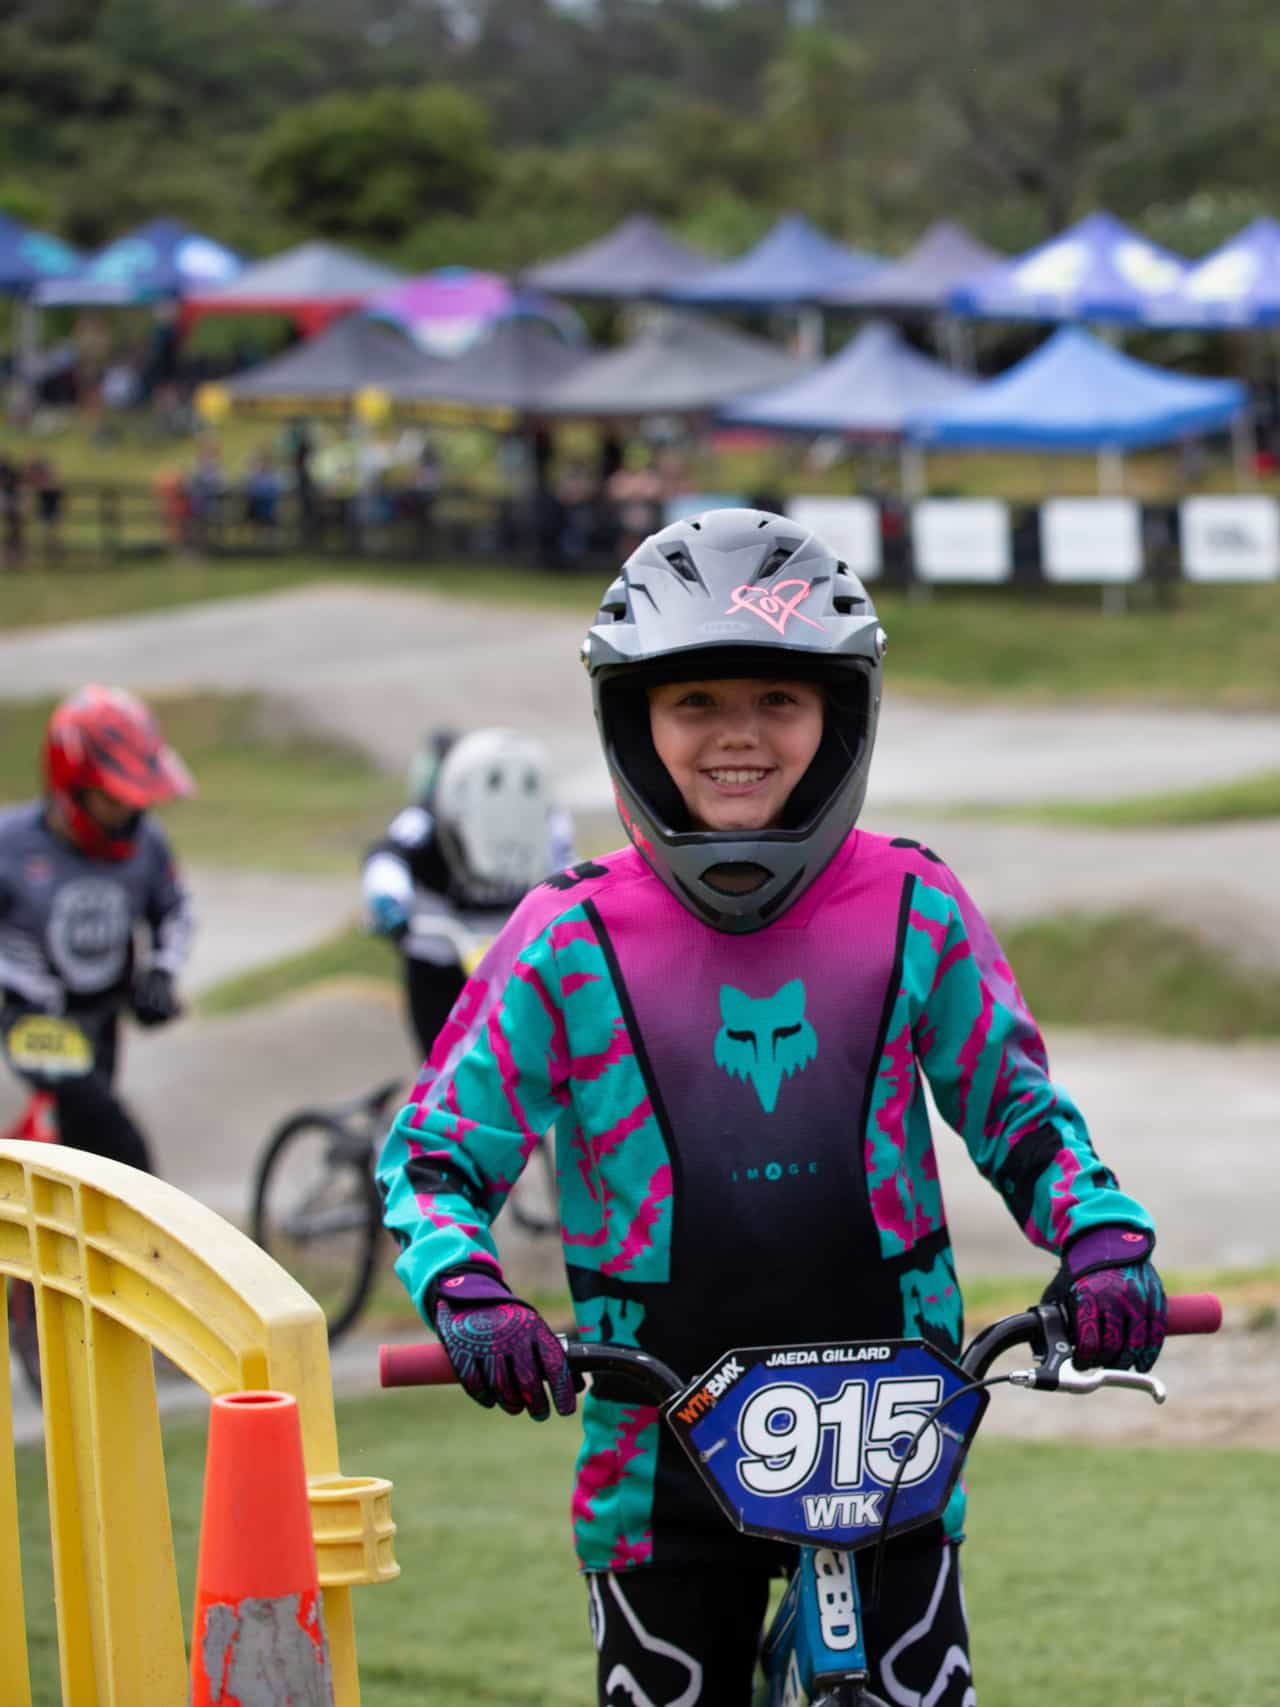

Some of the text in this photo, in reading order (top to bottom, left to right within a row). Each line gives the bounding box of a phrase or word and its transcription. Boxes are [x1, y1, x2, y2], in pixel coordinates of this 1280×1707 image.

[731, 1161, 818, 1182] IMAGE
[766, 1346, 891, 1368] JAEDA GILLARD
[737, 1376, 943, 1496] 915
[803, 1491, 884, 1530] WTK
